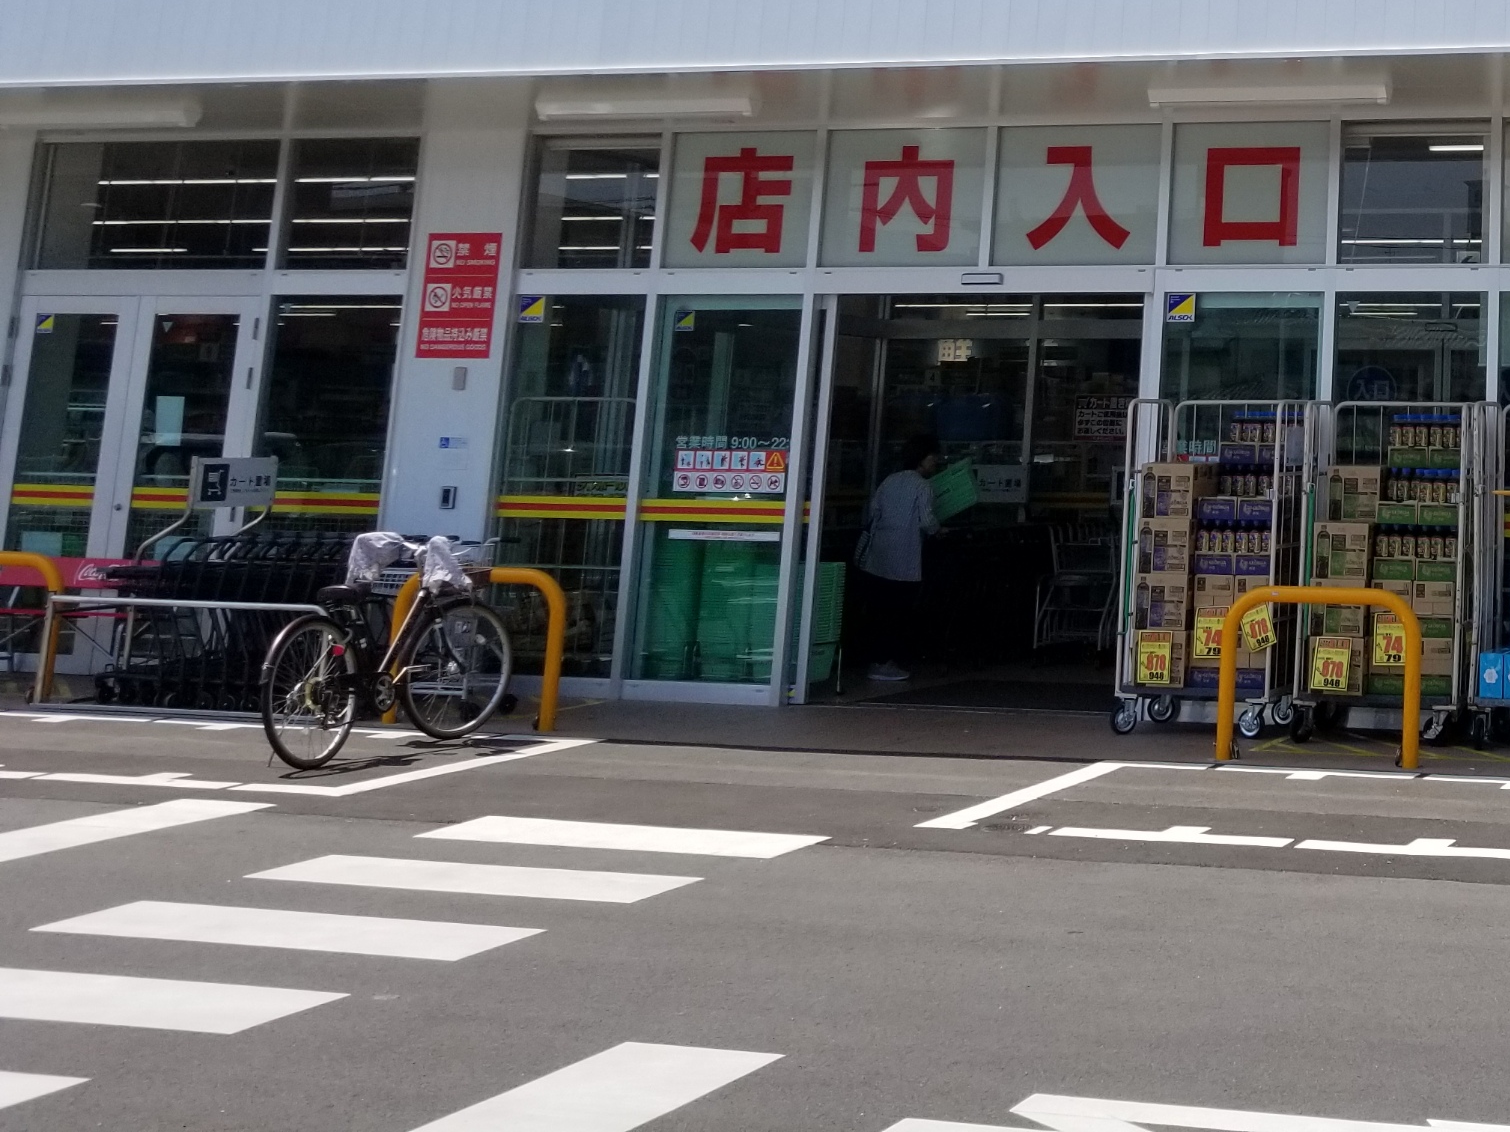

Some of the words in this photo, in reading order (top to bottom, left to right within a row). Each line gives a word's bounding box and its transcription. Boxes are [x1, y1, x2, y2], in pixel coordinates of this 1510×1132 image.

[689, 144, 1302, 255] 店内入口
[675, 435, 728, 449] 営業時間
[1382, 635, 1404, 654] 74
